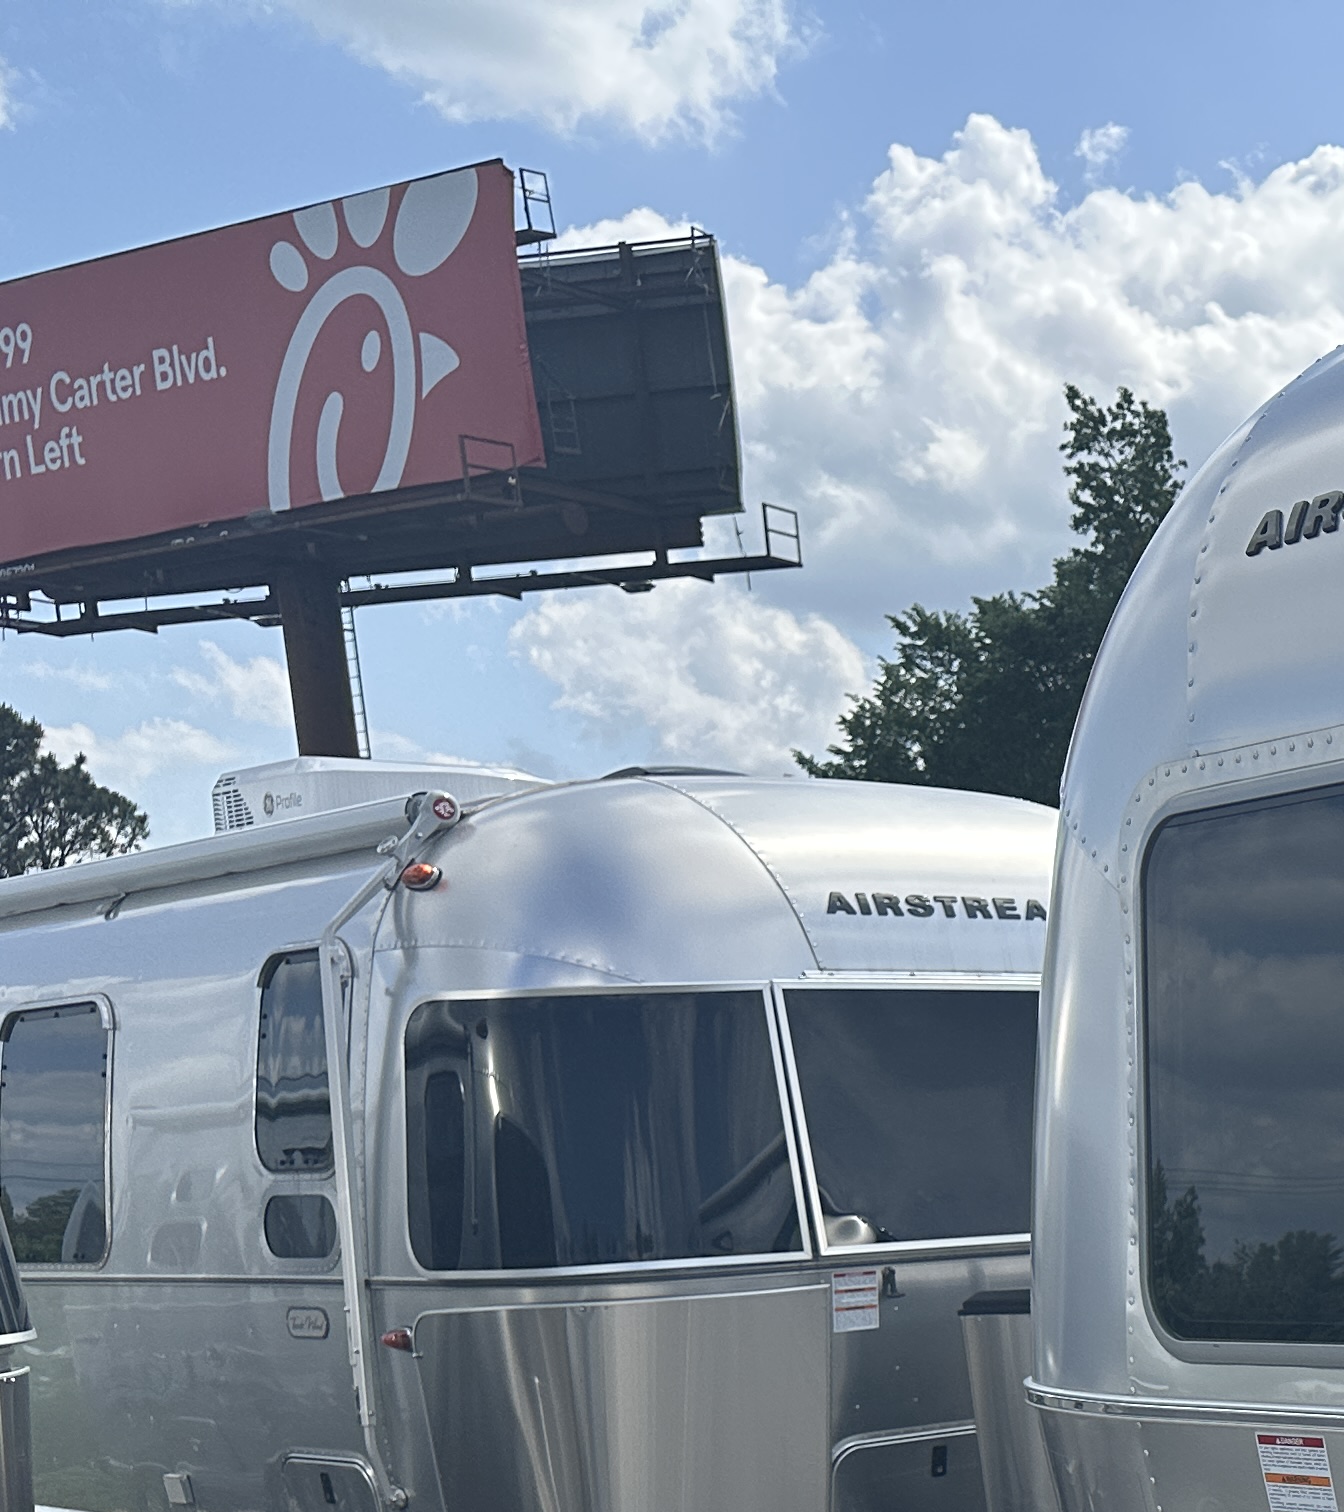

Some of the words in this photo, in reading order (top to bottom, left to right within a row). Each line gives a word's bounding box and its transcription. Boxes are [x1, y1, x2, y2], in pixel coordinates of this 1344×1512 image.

[0, 386, 43, 430] my
[50, 361, 146, 413] Carter
[152, 336, 227, 391] Blvd.
[0, 447, 22, 481] n
[26, 425, 87, 475] Left
